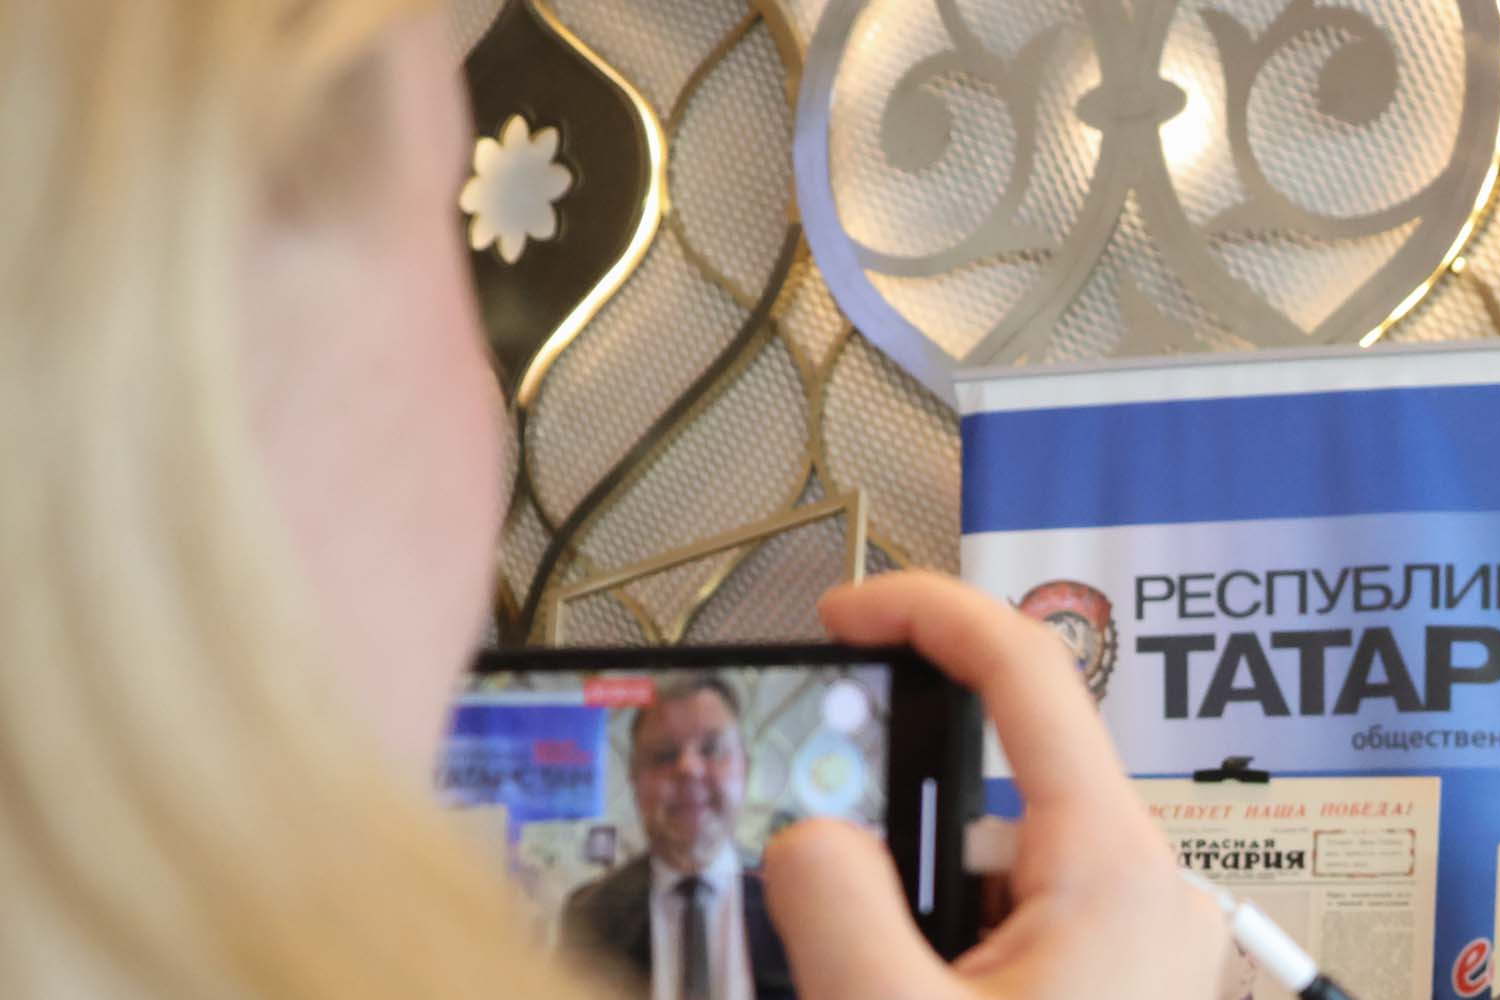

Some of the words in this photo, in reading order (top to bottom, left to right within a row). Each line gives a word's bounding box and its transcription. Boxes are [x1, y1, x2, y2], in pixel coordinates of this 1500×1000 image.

[1245, 803, 1306, 818] НАША
[1320, 801, 1414, 817] ПОБЕДА!
[1181, 838, 1276, 850] КРАСНАЯ
